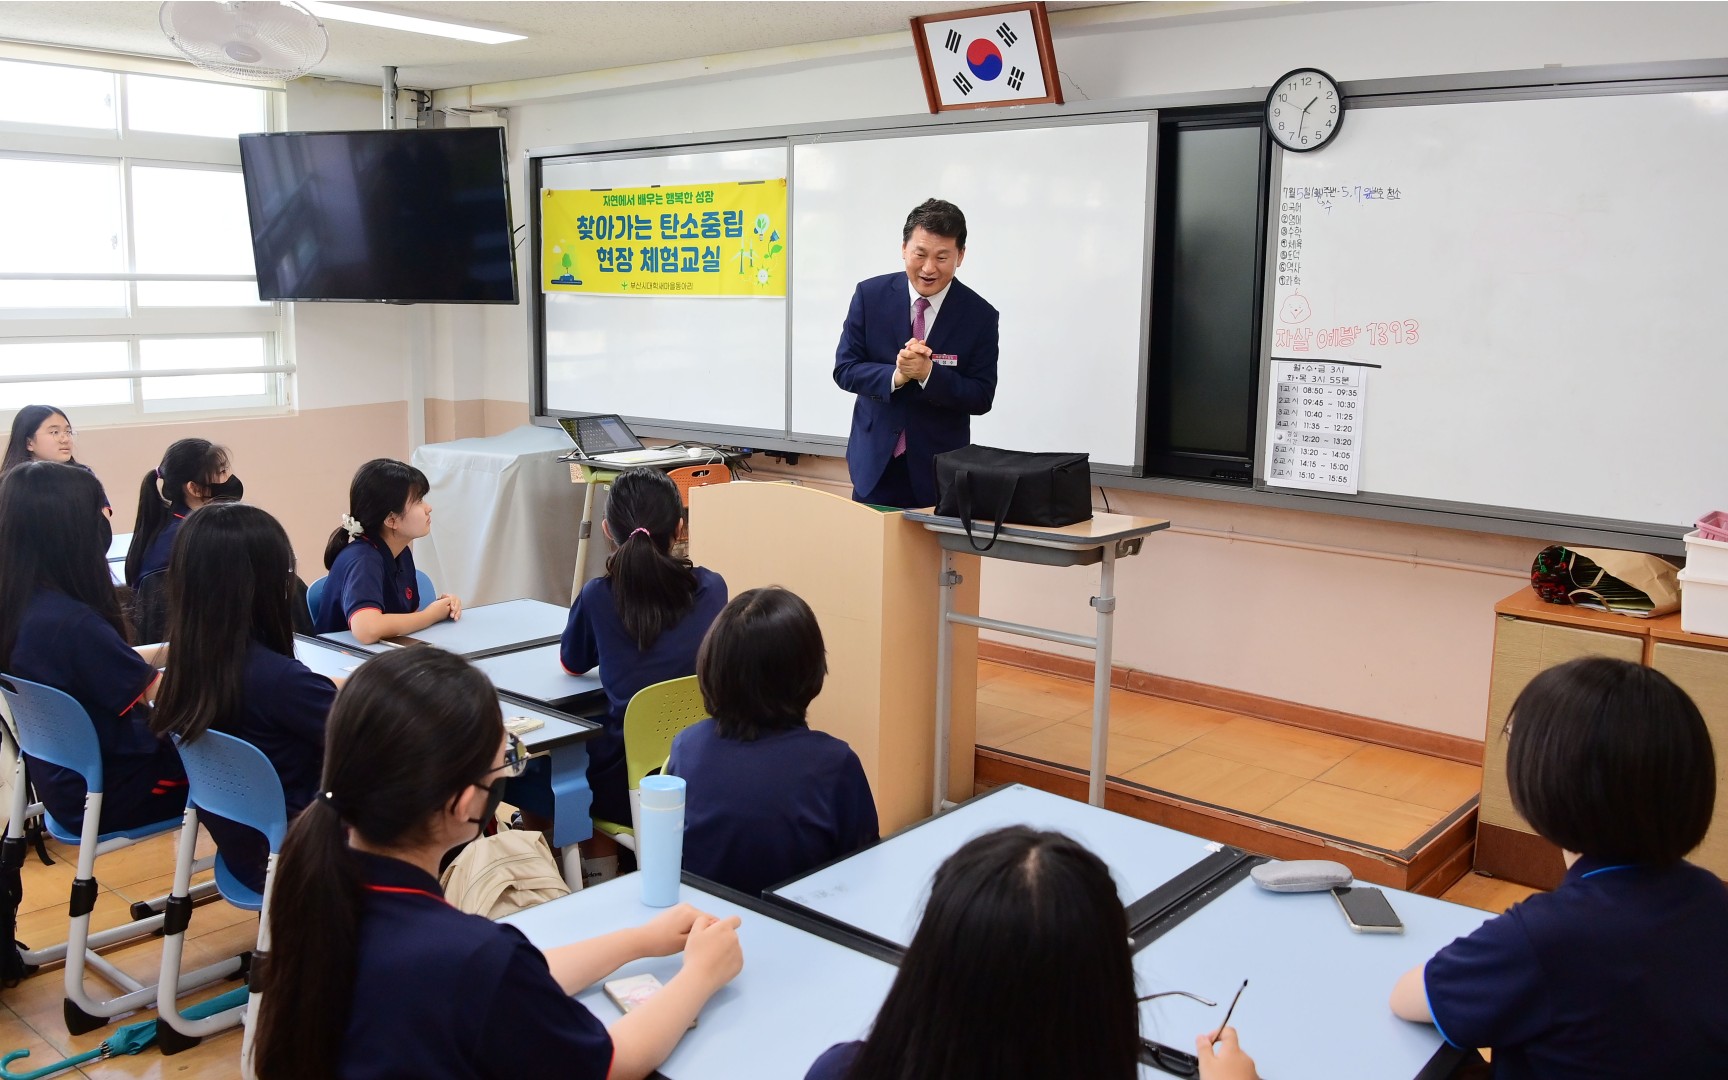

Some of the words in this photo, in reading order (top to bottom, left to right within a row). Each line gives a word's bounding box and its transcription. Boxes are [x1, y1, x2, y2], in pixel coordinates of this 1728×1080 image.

[1301, 77, 1312, 86] 12
[1318, 81, 1322, 89] 1
[1288, 82, 1297, 91] 11
[1278, 93, 1288, 102] 10
[1326, 91, 1333, 100] 2
[1274, 108, 1281, 117] 9
[1330, 105, 1337, 114] 3
[1278, 122, 1285, 131] 8
[1325, 120, 1332, 128] 4
[1289, 132, 1295, 141] 7
[1301, 135, 1308, 145] 6
[1315, 131, 1322, 140] 5
[603, 194, 635, 207] 자연에서
[638, 193, 663, 205] 배우는
[665, 191, 693, 204] 행복한
[696, 190, 715, 203] 성장
[577, 214, 652, 241] 찾아가는
[660, 209, 744, 240] 탄소중립
[596, 246, 633, 273] 현장
[640, 245, 721, 273] 체험교실
[1275, 328, 1314, 352] 자살
[1316, 326, 1362, 350] 예방
[1366, 318, 1420, 346] 1393
[1330, 366, 1345, 374] 3시
[1311, 375, 1326, 384] 3시
[1303, 387, 1324, 395] 08:50
[1336, 389, 1358, 397] 09:35
[1303, 398, 1324, 407] 09:45
[1337, 401, 1356, 409] 10:30
[1304, 411, 1323, 419] 10:40
[1336, 412, 1353, 421] 11:25
[1303, 422, 1320, 430] 11:35
[1333, 424, 1353, 433] 12:20
[1302, 434, 1320, 443] 12:20
[1333, 437, 1352, 446] 13:20
[1300, 448, 1319, 456] 13:20
[1331, 450, 1351, 459] 14:05
[1300, 459, 1317, 468] 14:15
[1329, 462, 1349, 471] 15:00
[1298, 471, 1316, 480] 15:10
[1328, 474, 1348, 483] 15:55
